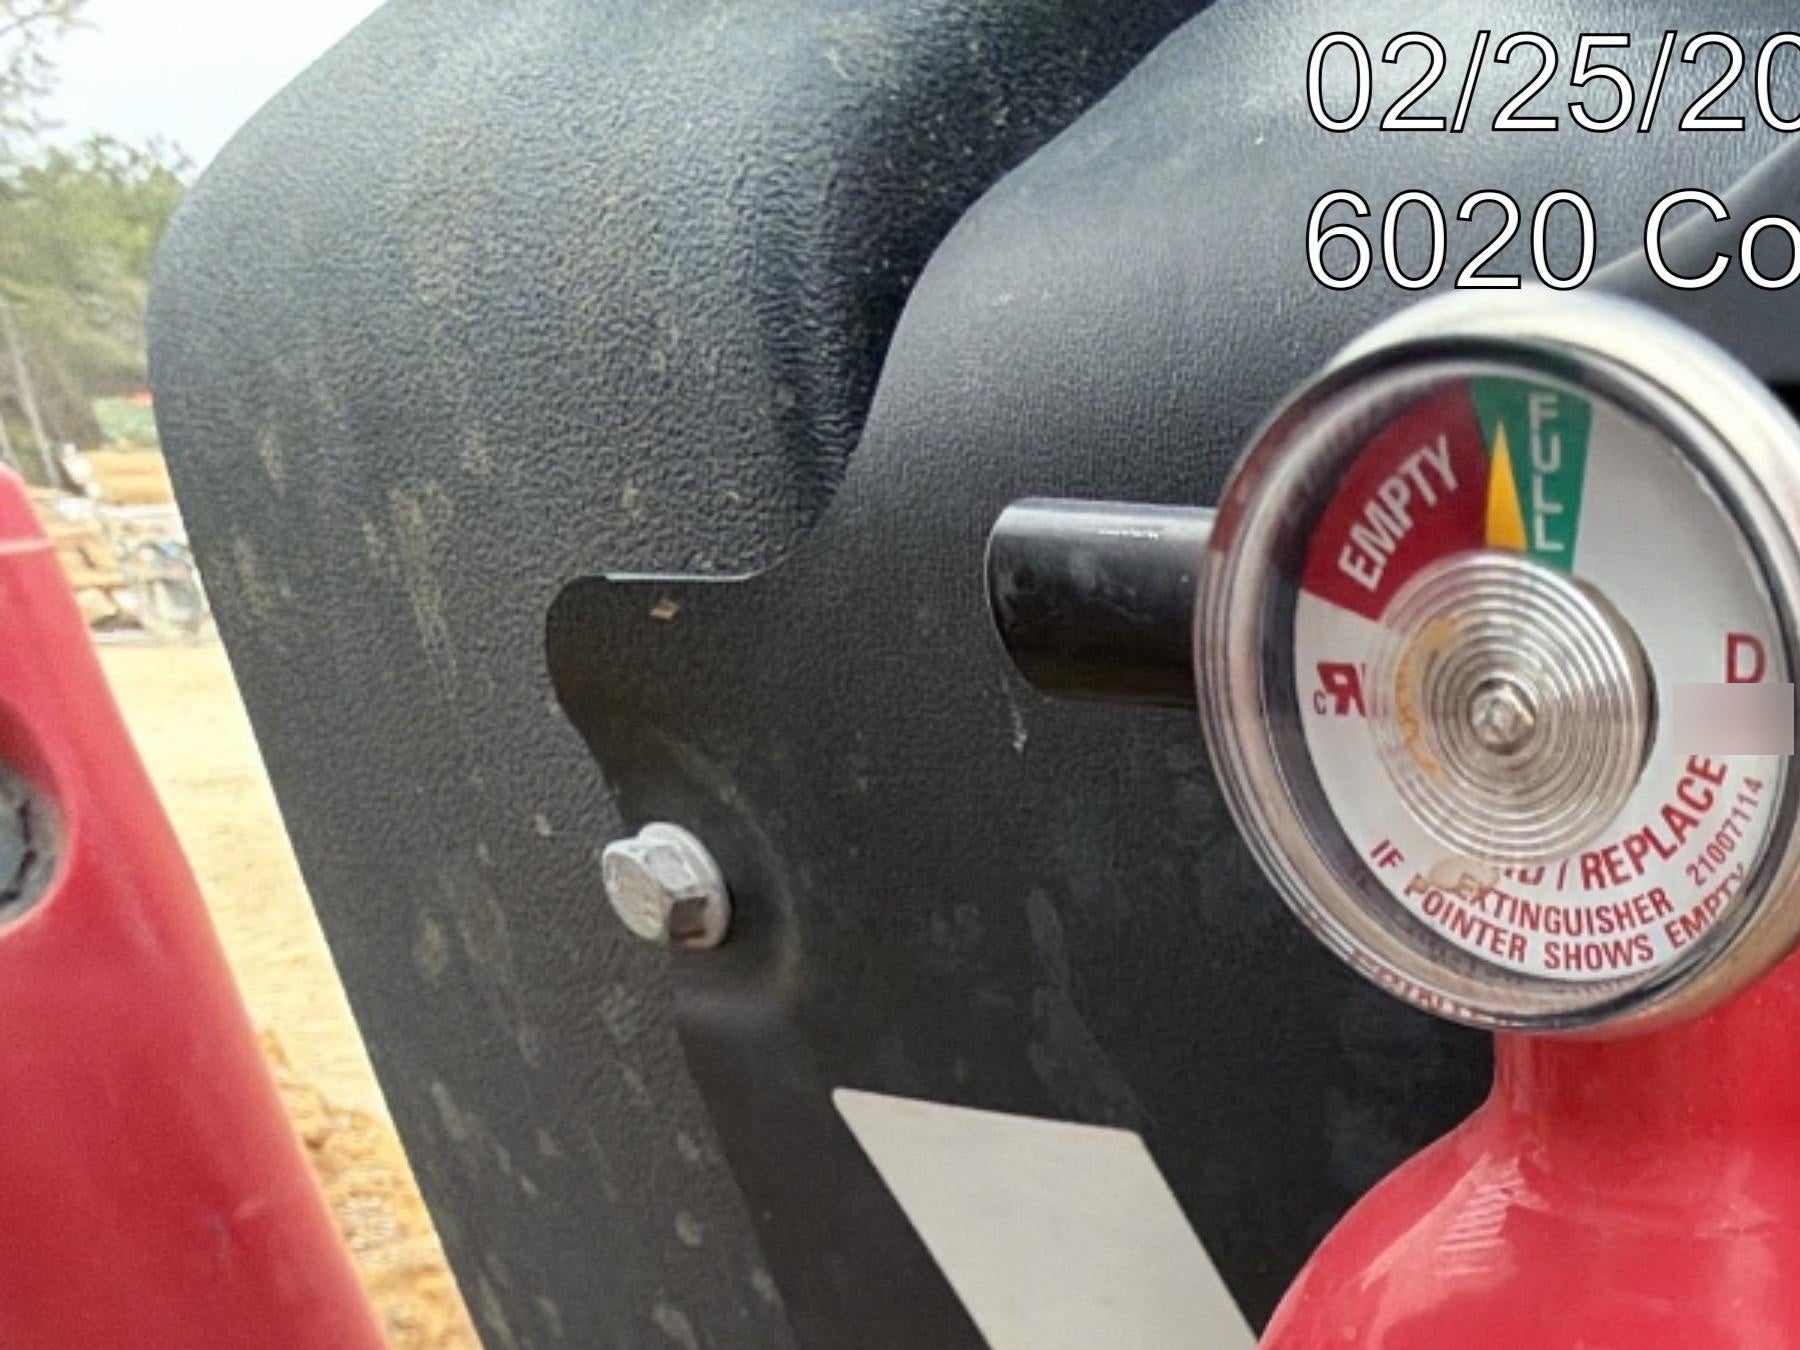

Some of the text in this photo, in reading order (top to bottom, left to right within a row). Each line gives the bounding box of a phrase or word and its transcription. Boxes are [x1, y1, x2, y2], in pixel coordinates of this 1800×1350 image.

[1338, 434, 1458, 592] EMPTY
[1530, 392, 1564, 552] FULL
[1580, 753, 1728, 891] REPLACE
[1685, 776, 1764, 888] 21007114
[1370, 839, 1746, 972] IF POINTER SHOWS EMPTY
[1456, 871, 1674, 938] EXTINGUISHER
